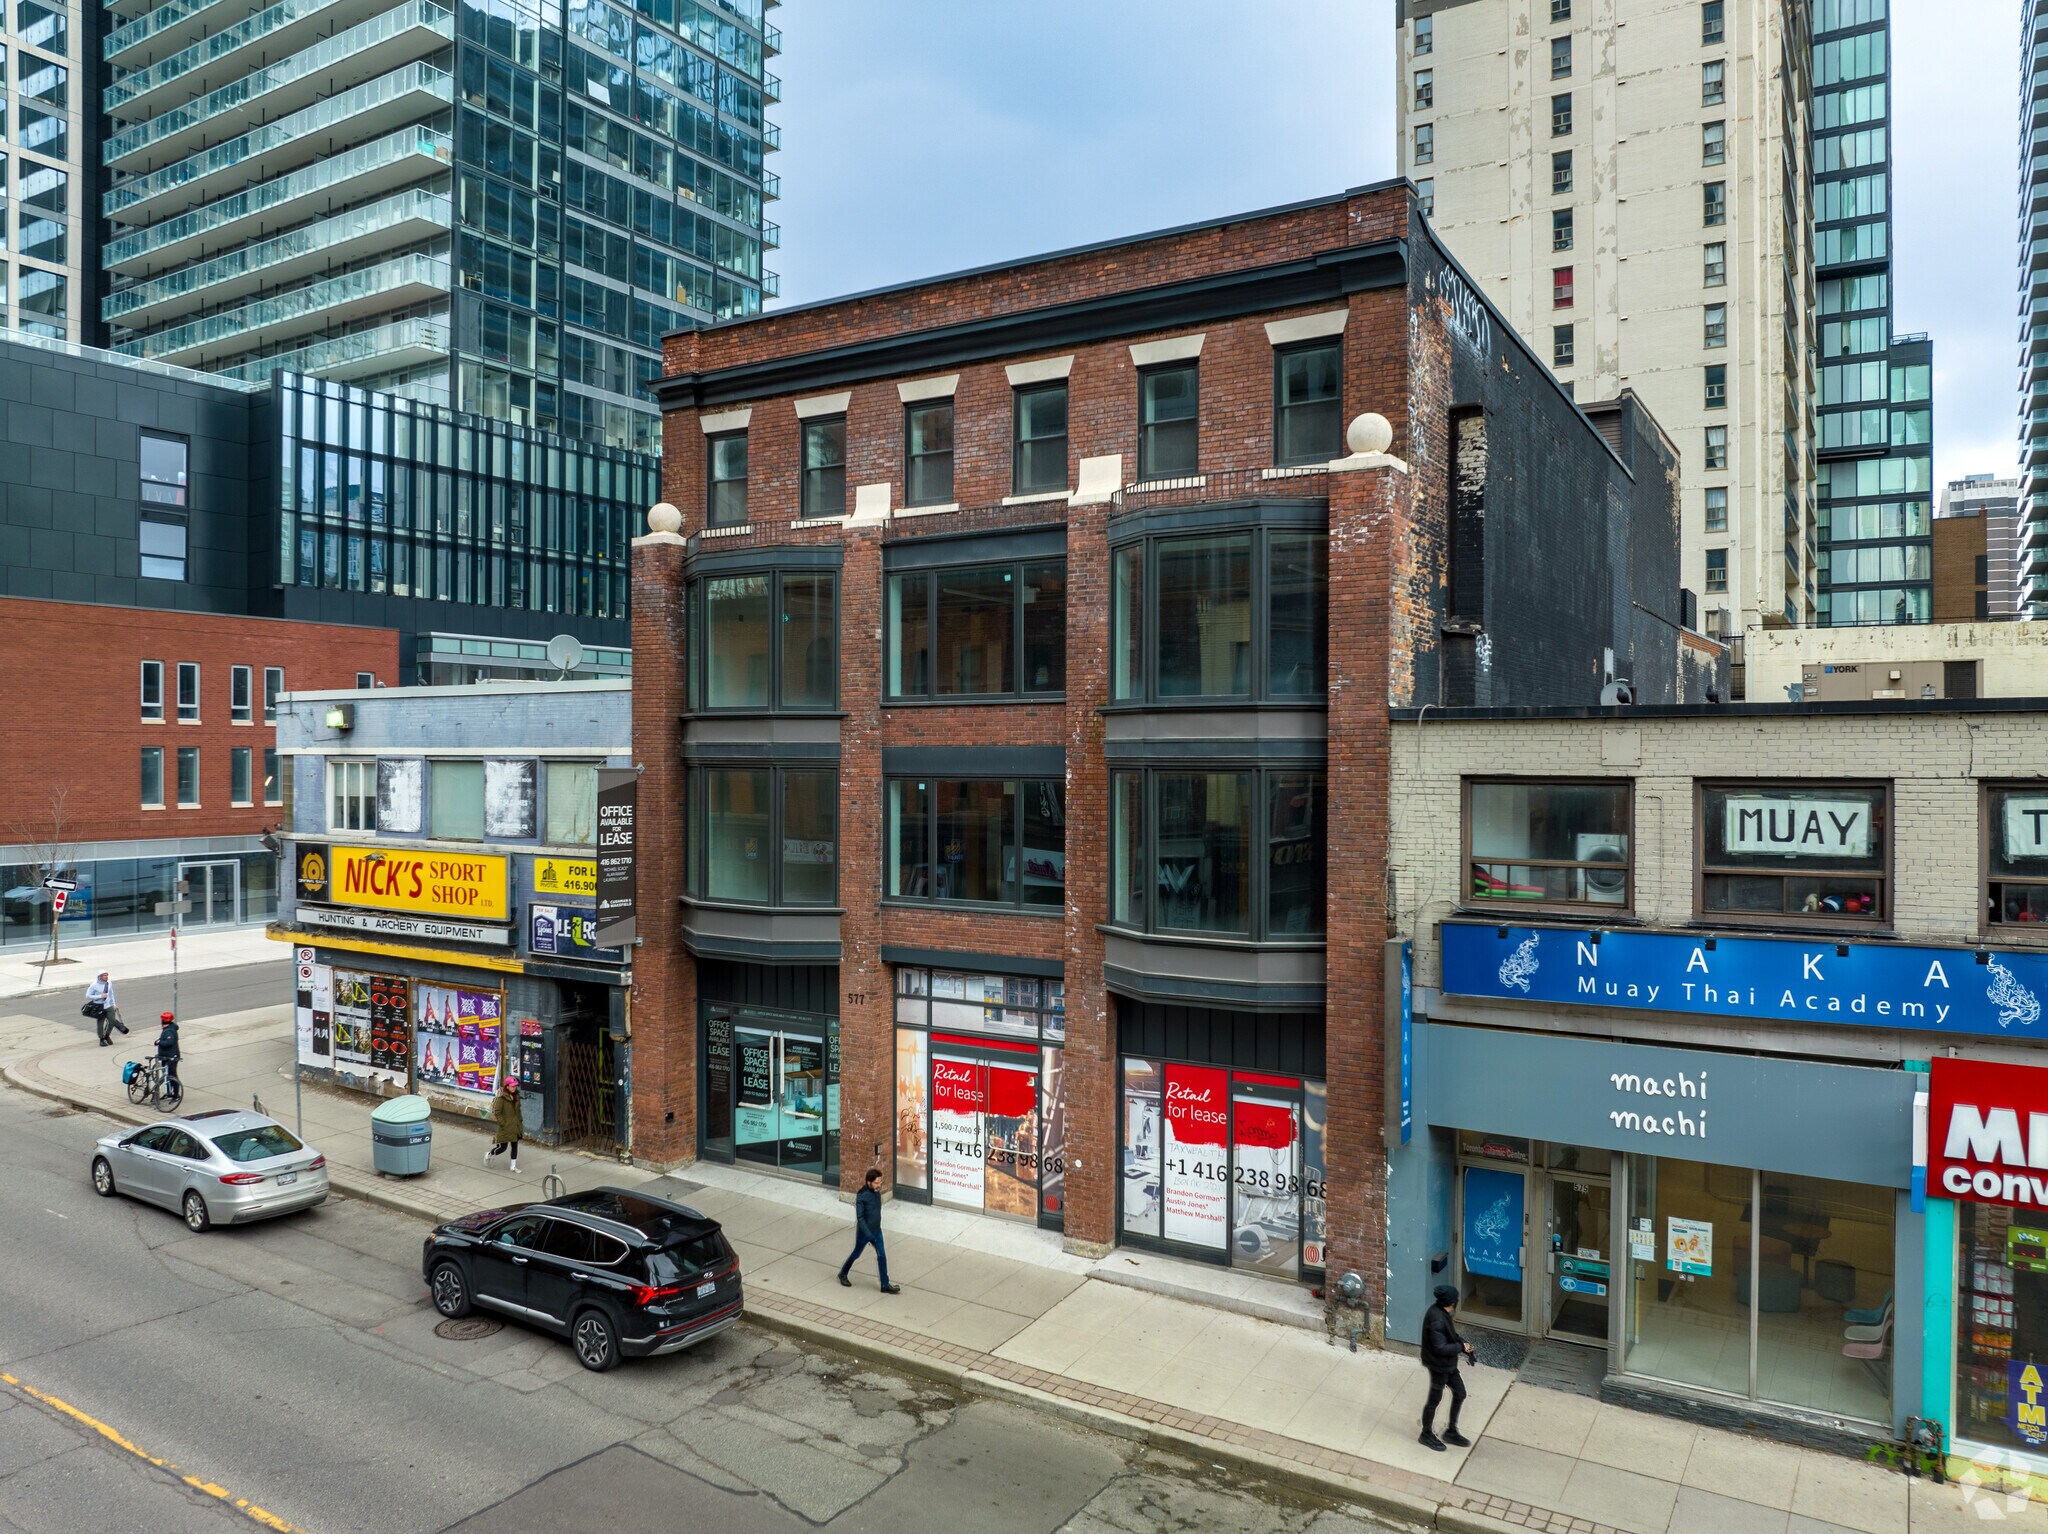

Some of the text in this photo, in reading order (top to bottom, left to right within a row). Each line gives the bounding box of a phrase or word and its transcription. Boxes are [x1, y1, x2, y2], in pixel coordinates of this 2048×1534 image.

[1833, 665, 1858, 673] YORK
[600, 805, 633, 817] OFFICE
[600, 817, 633, 826] AVAILABLE
[1739, 808, 1859, 845] MUAY
[600, 832, 633, 846] LEASE
[430, 861, 486, 882] SPORT
[569, 866, 587, 876] FOR
[345, 857, 423, 898] NICK'S
[432, 885, 478, 905] SHOP
[319, 913, 483, 939] HUNTING & ARCHERY EQUIPMENT
[848, 993, 865, 1005] 577
[1578, 976, 1950, 1024] Muay Thai Academy
[708, 1020, 730, 1030] OFFICE
[709, 1028, 729, 1038] SPACE
[708, 1045, 730, 1057] LEASE
[743, 1047, 769, 1059] OFFICE
[744, 1056, 767, 1068] SPACE
[743, 1065, 769, 1076] AVAILABLE
[934, 1063, 971, 1083] Retail
[743, 1076, 769, 1090] LEASE
[1610, 1071, 1707, 1100] machi
[935, 1082, 983, 1102] for lease
[1166, 1082, 1211, 1103] Retail
[1168, 1101, 1227, 1124] for lease
[934, 1121, 972, 1134] 1,500-7,000
[1609, 1109, 1706, 1138] machi
[955, 1141, 982, 1159] 416
[988, 1149, 1015, 1166] 238
[934, 1159, 956, 1169] Brandon
[934, 1168, 951, 1176] Austin
[1166, 1159, 1187, 1175] +1
[1193, 1162, 1227, 1181] 416
[1235, 1167, 1269, 1188] 238
[934, 1176, 956, 1186] Matthew
[1166, 1187, 1193, 1198] Brandon
[1573, 1184, 1588, 1192] 575
[1166, 1197, 1187, 1207] Austin
[1166, 1206, 1194, 1218] Matthew
[1493, 1258, 1515, 1268] Academy
[2018, 1365, 2046, 1426] ATM
